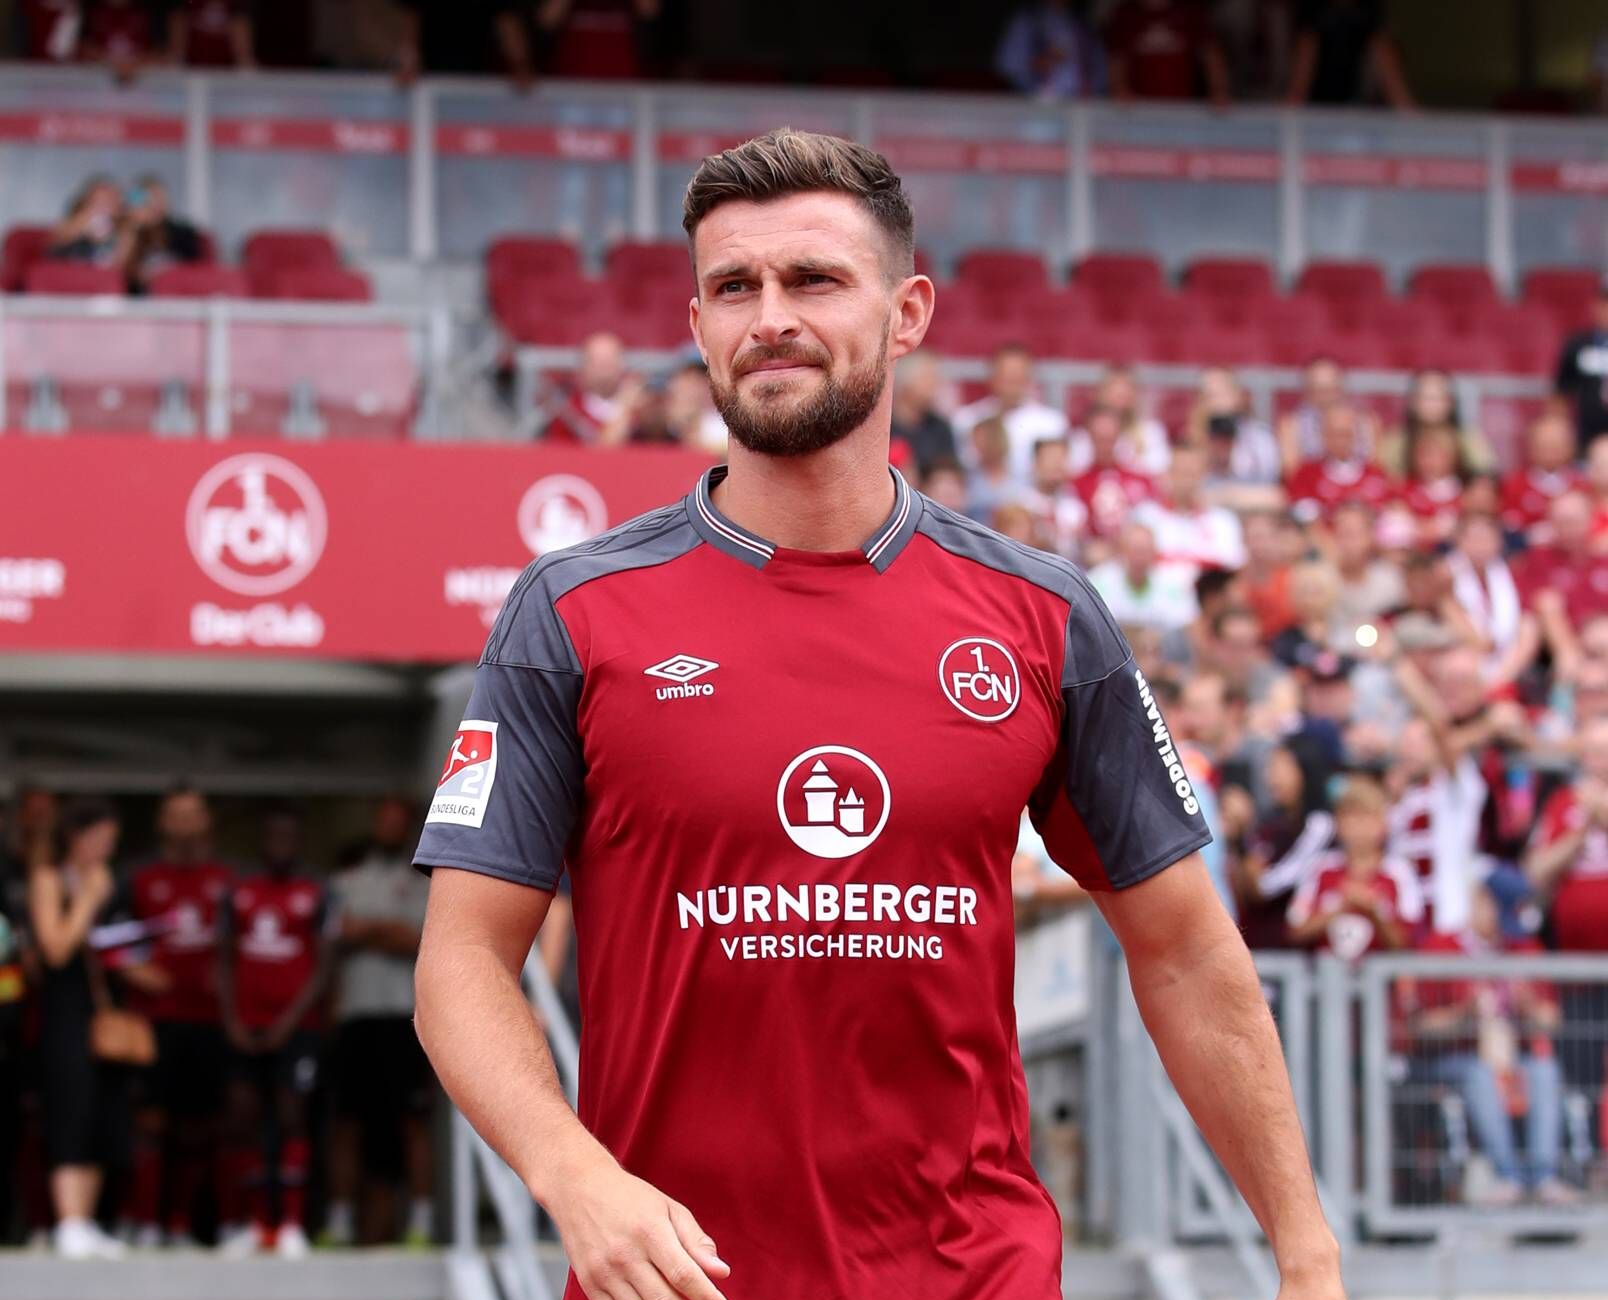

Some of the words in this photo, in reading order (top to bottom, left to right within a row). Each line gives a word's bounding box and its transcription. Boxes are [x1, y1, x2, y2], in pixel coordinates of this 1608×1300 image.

[655, 682, 715, 701] umbro
[952, 672, 1013, 704] FCN
[459, 765, 485, 796] 2
[676, 883, 978, 930] NÜRNBERGER
[719, 934, 944, 961] VERSICHERUNG
